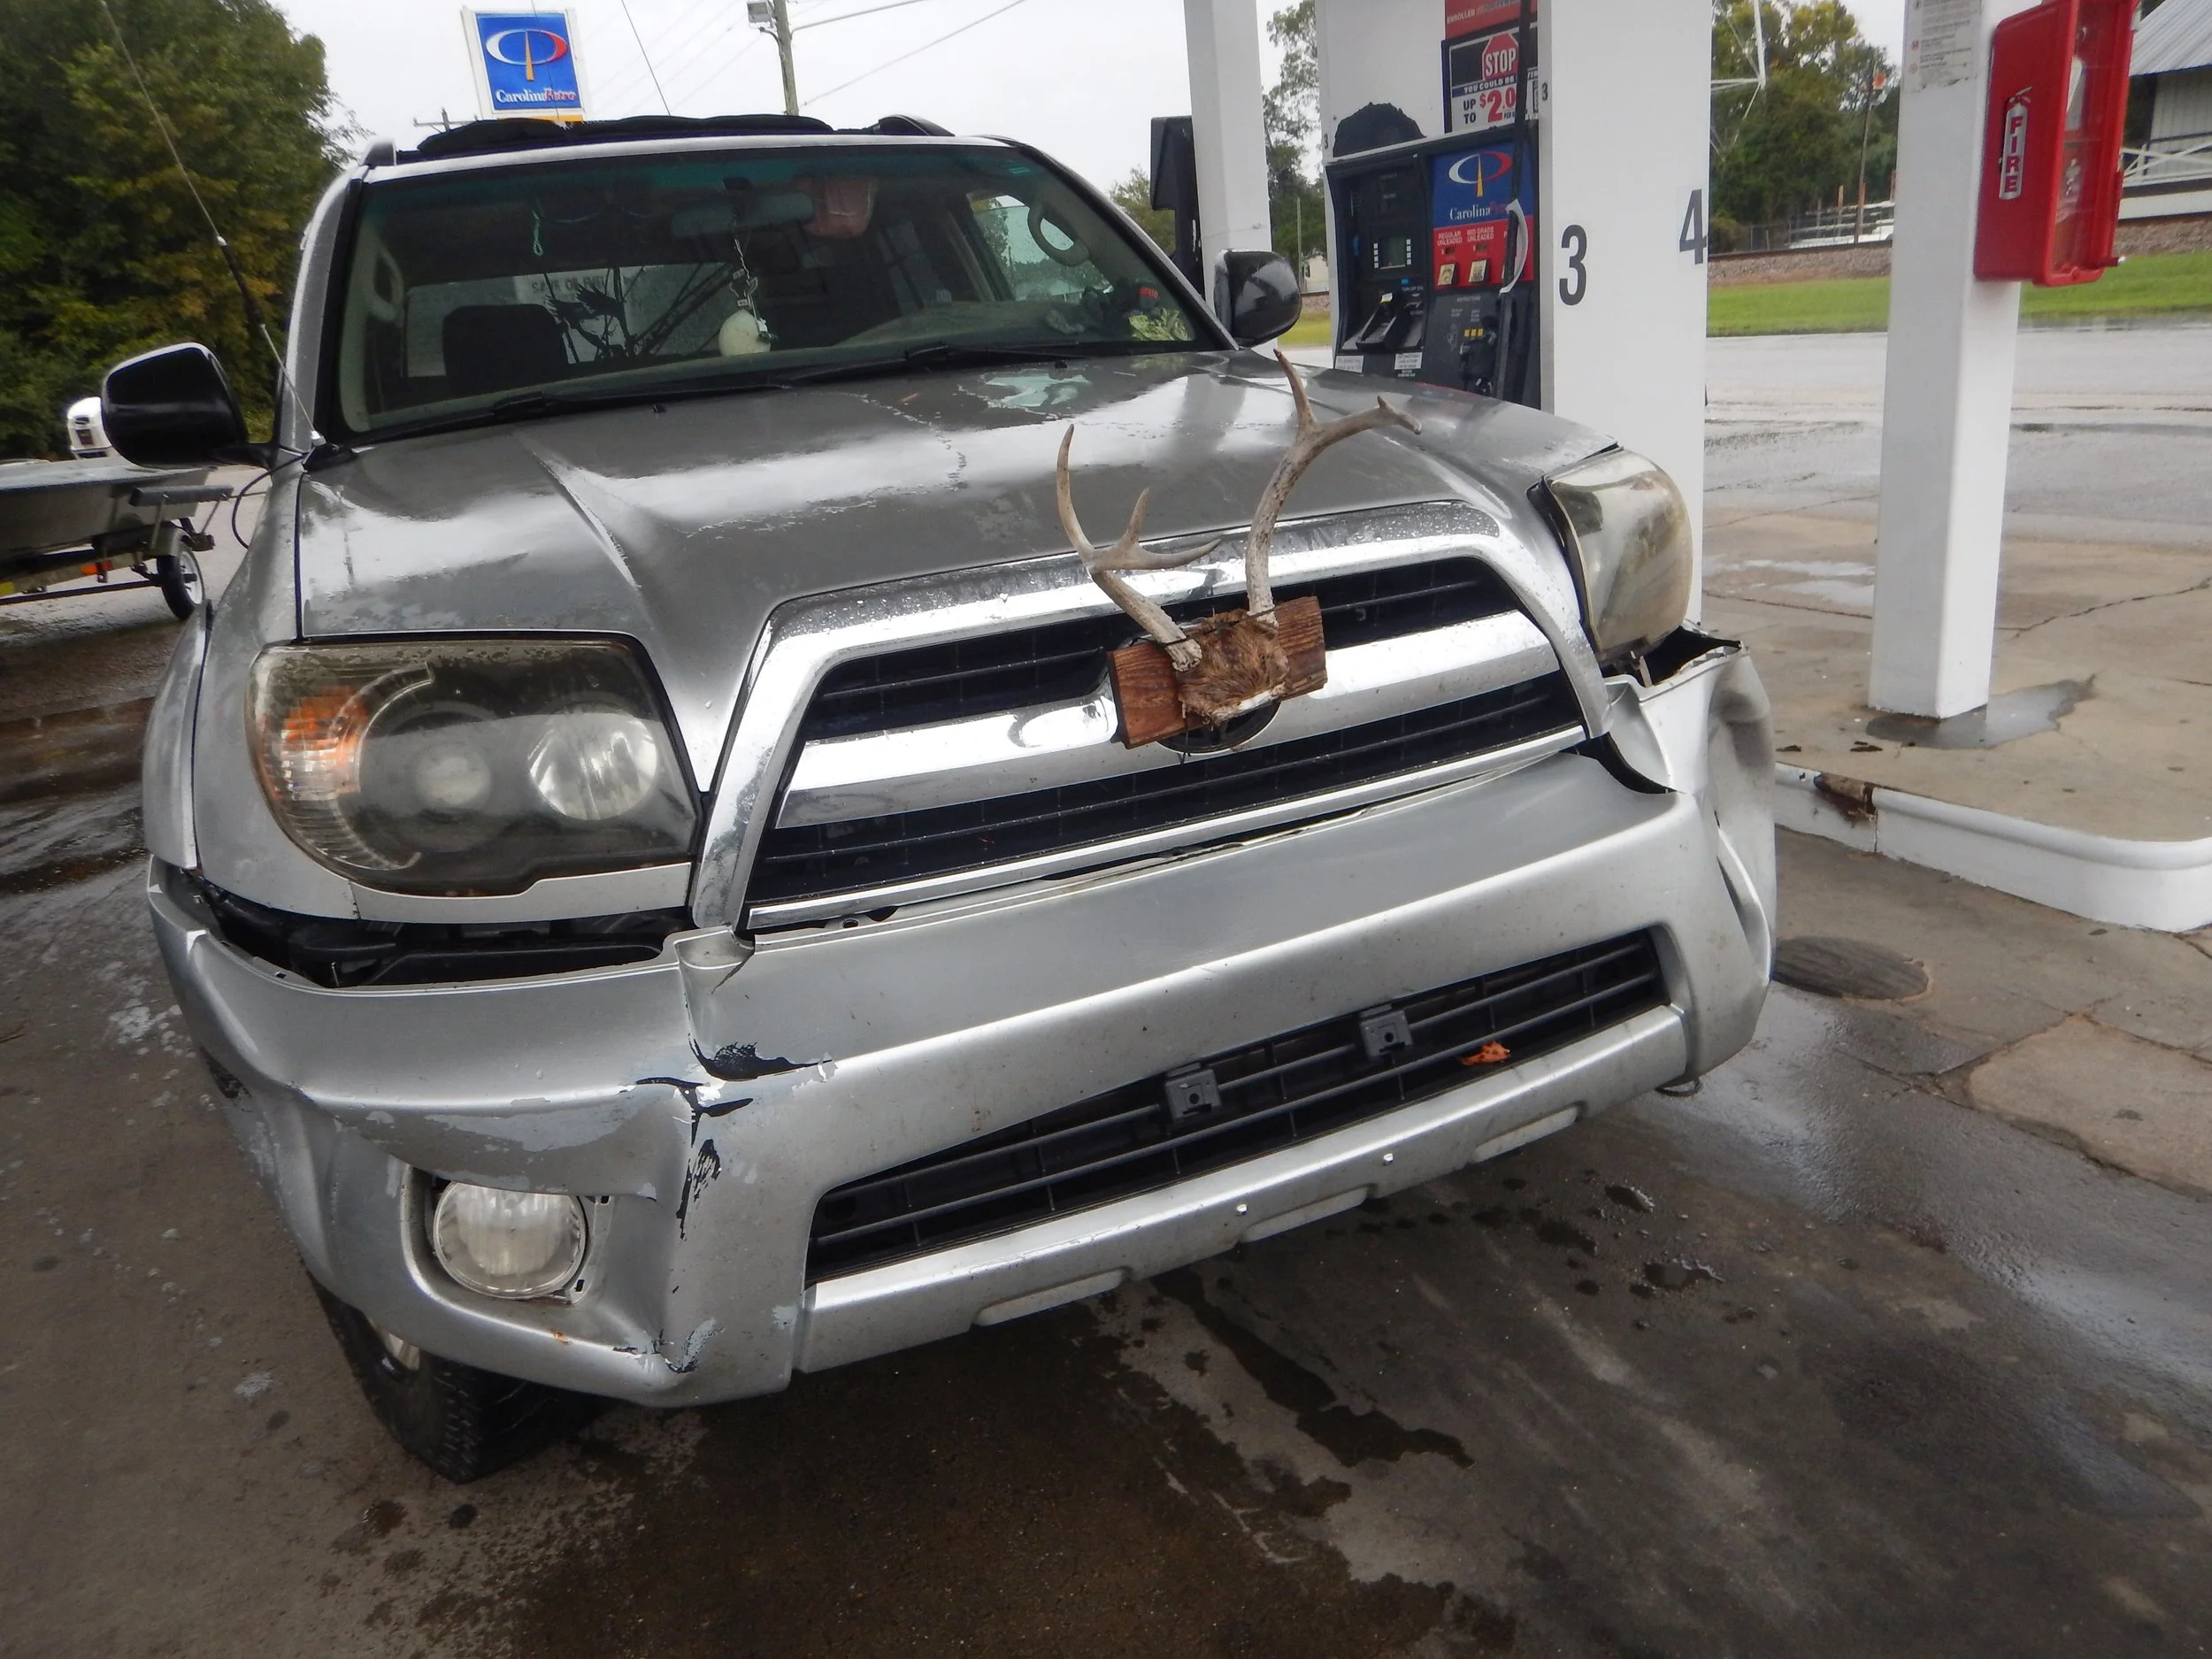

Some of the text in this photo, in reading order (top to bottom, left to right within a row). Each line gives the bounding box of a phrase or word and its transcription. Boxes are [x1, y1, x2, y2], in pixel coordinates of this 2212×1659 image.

[1485, 47, 1517, 77] STOP
[1463, 84, 1478, 95] YOU
[1479, 78, 1503, 91] COULD
[1541, 81, 1548, 101] 3
[1463, 98, 1477, 111] UP
[1463, 112, 1477, 125] TO
[2004, 115, 2024, 193] FIRE
[1678, 188, 1708, 265] 4
[1558, 224, 1587, 306] 3
